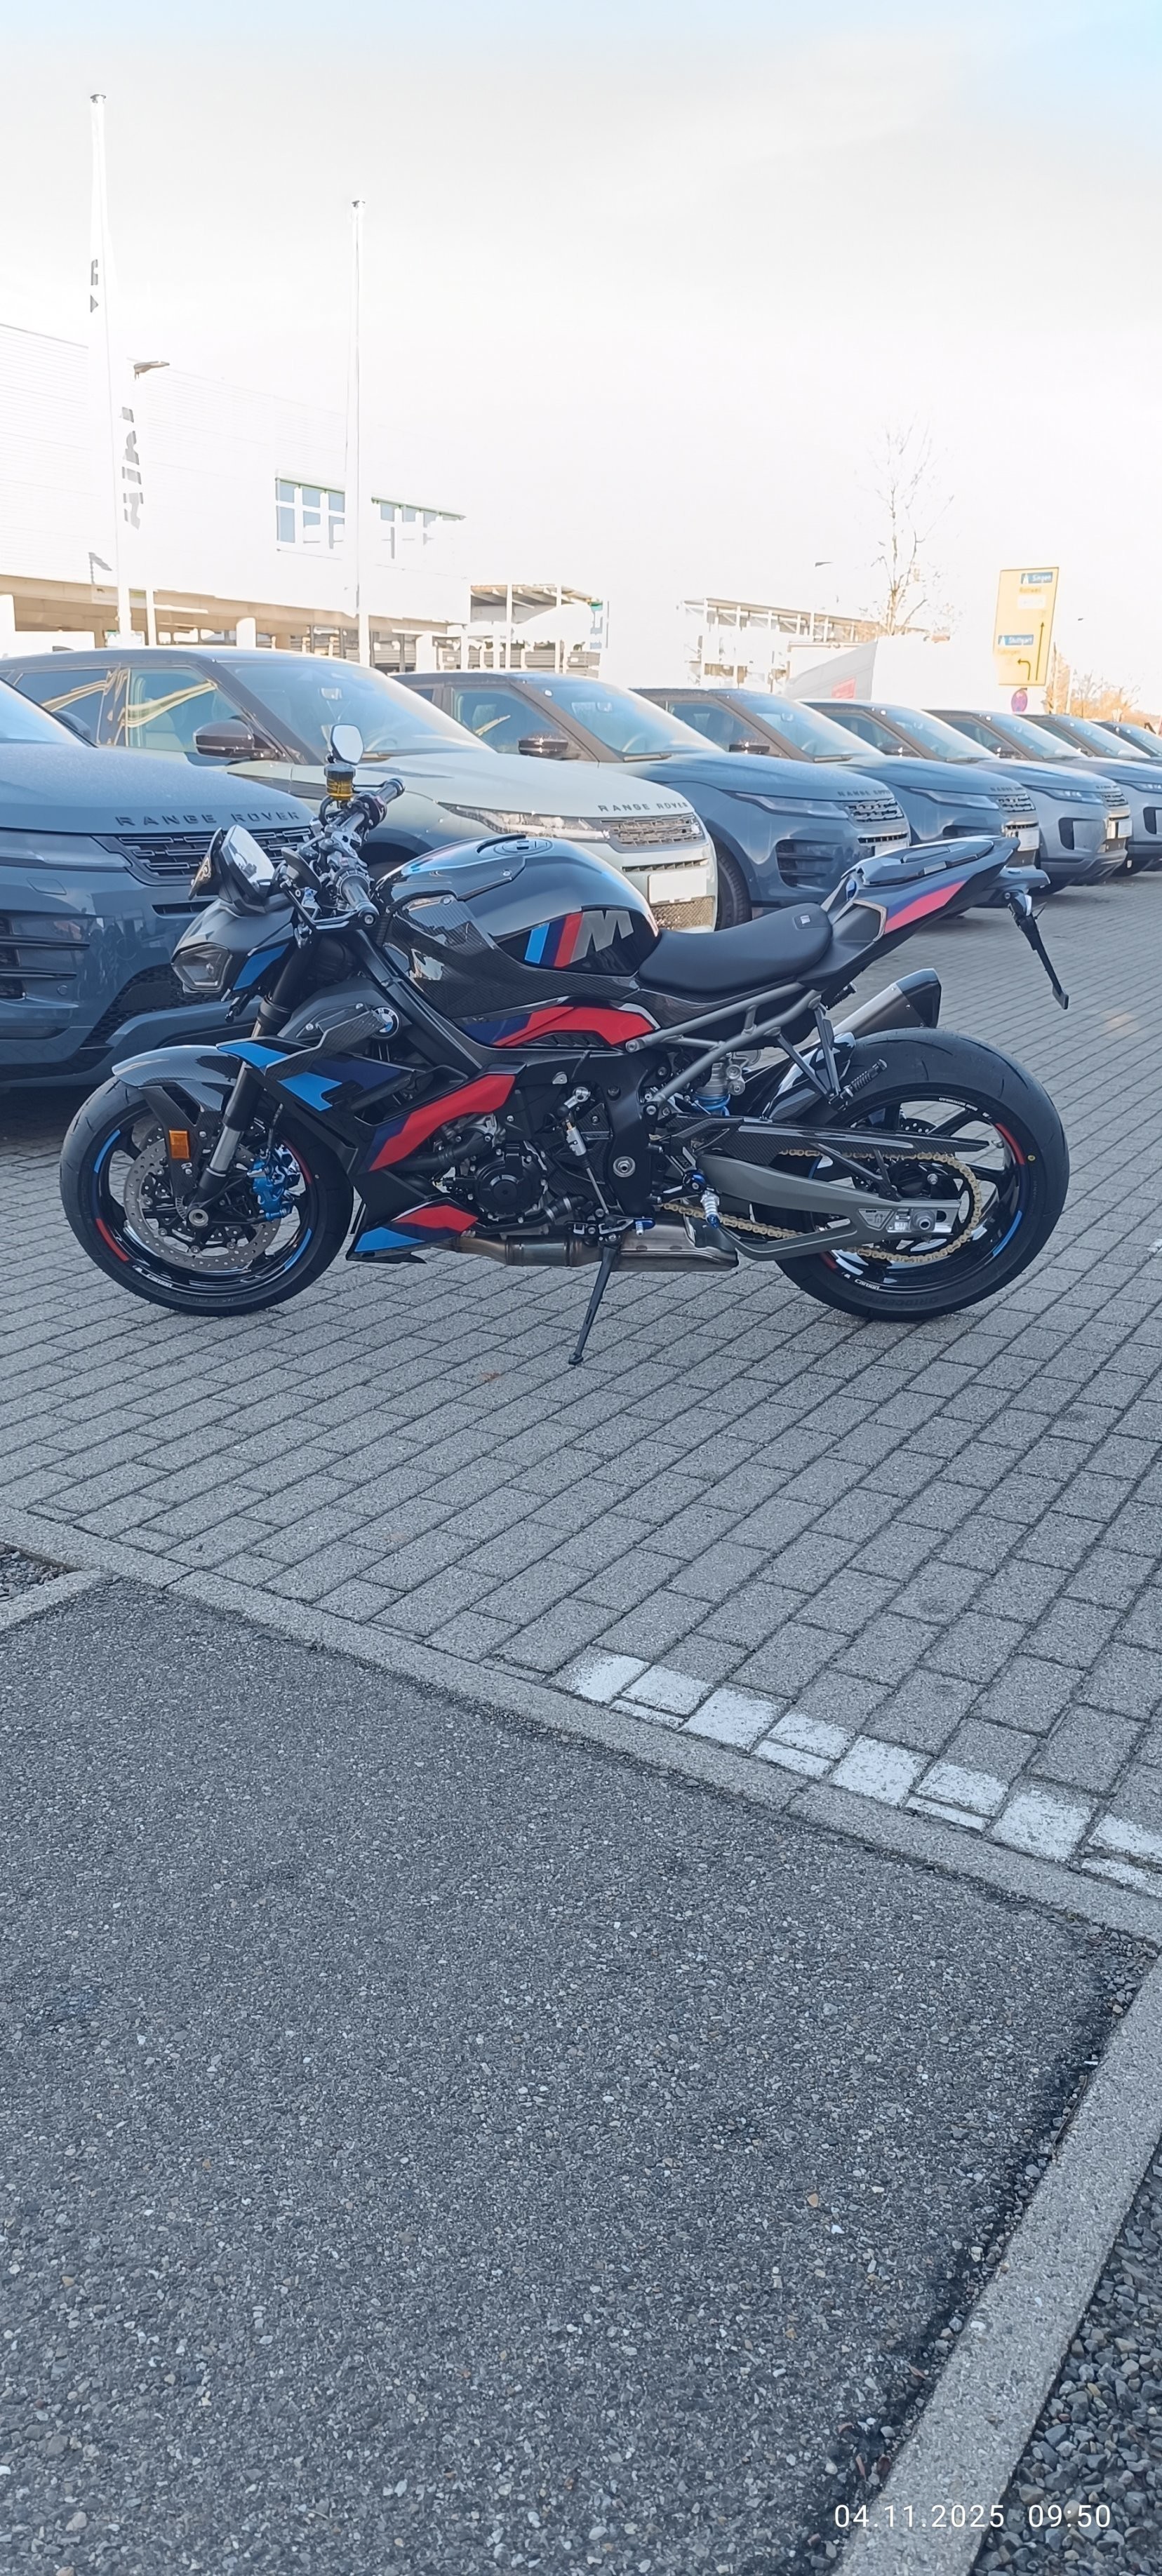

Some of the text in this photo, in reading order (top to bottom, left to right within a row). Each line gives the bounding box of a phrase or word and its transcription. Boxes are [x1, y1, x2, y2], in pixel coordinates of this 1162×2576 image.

[598, 803, 650, 812] RANGE
[114, 811, 300, 826] RANGE ROVER
[570, 911, 634, 963] M
